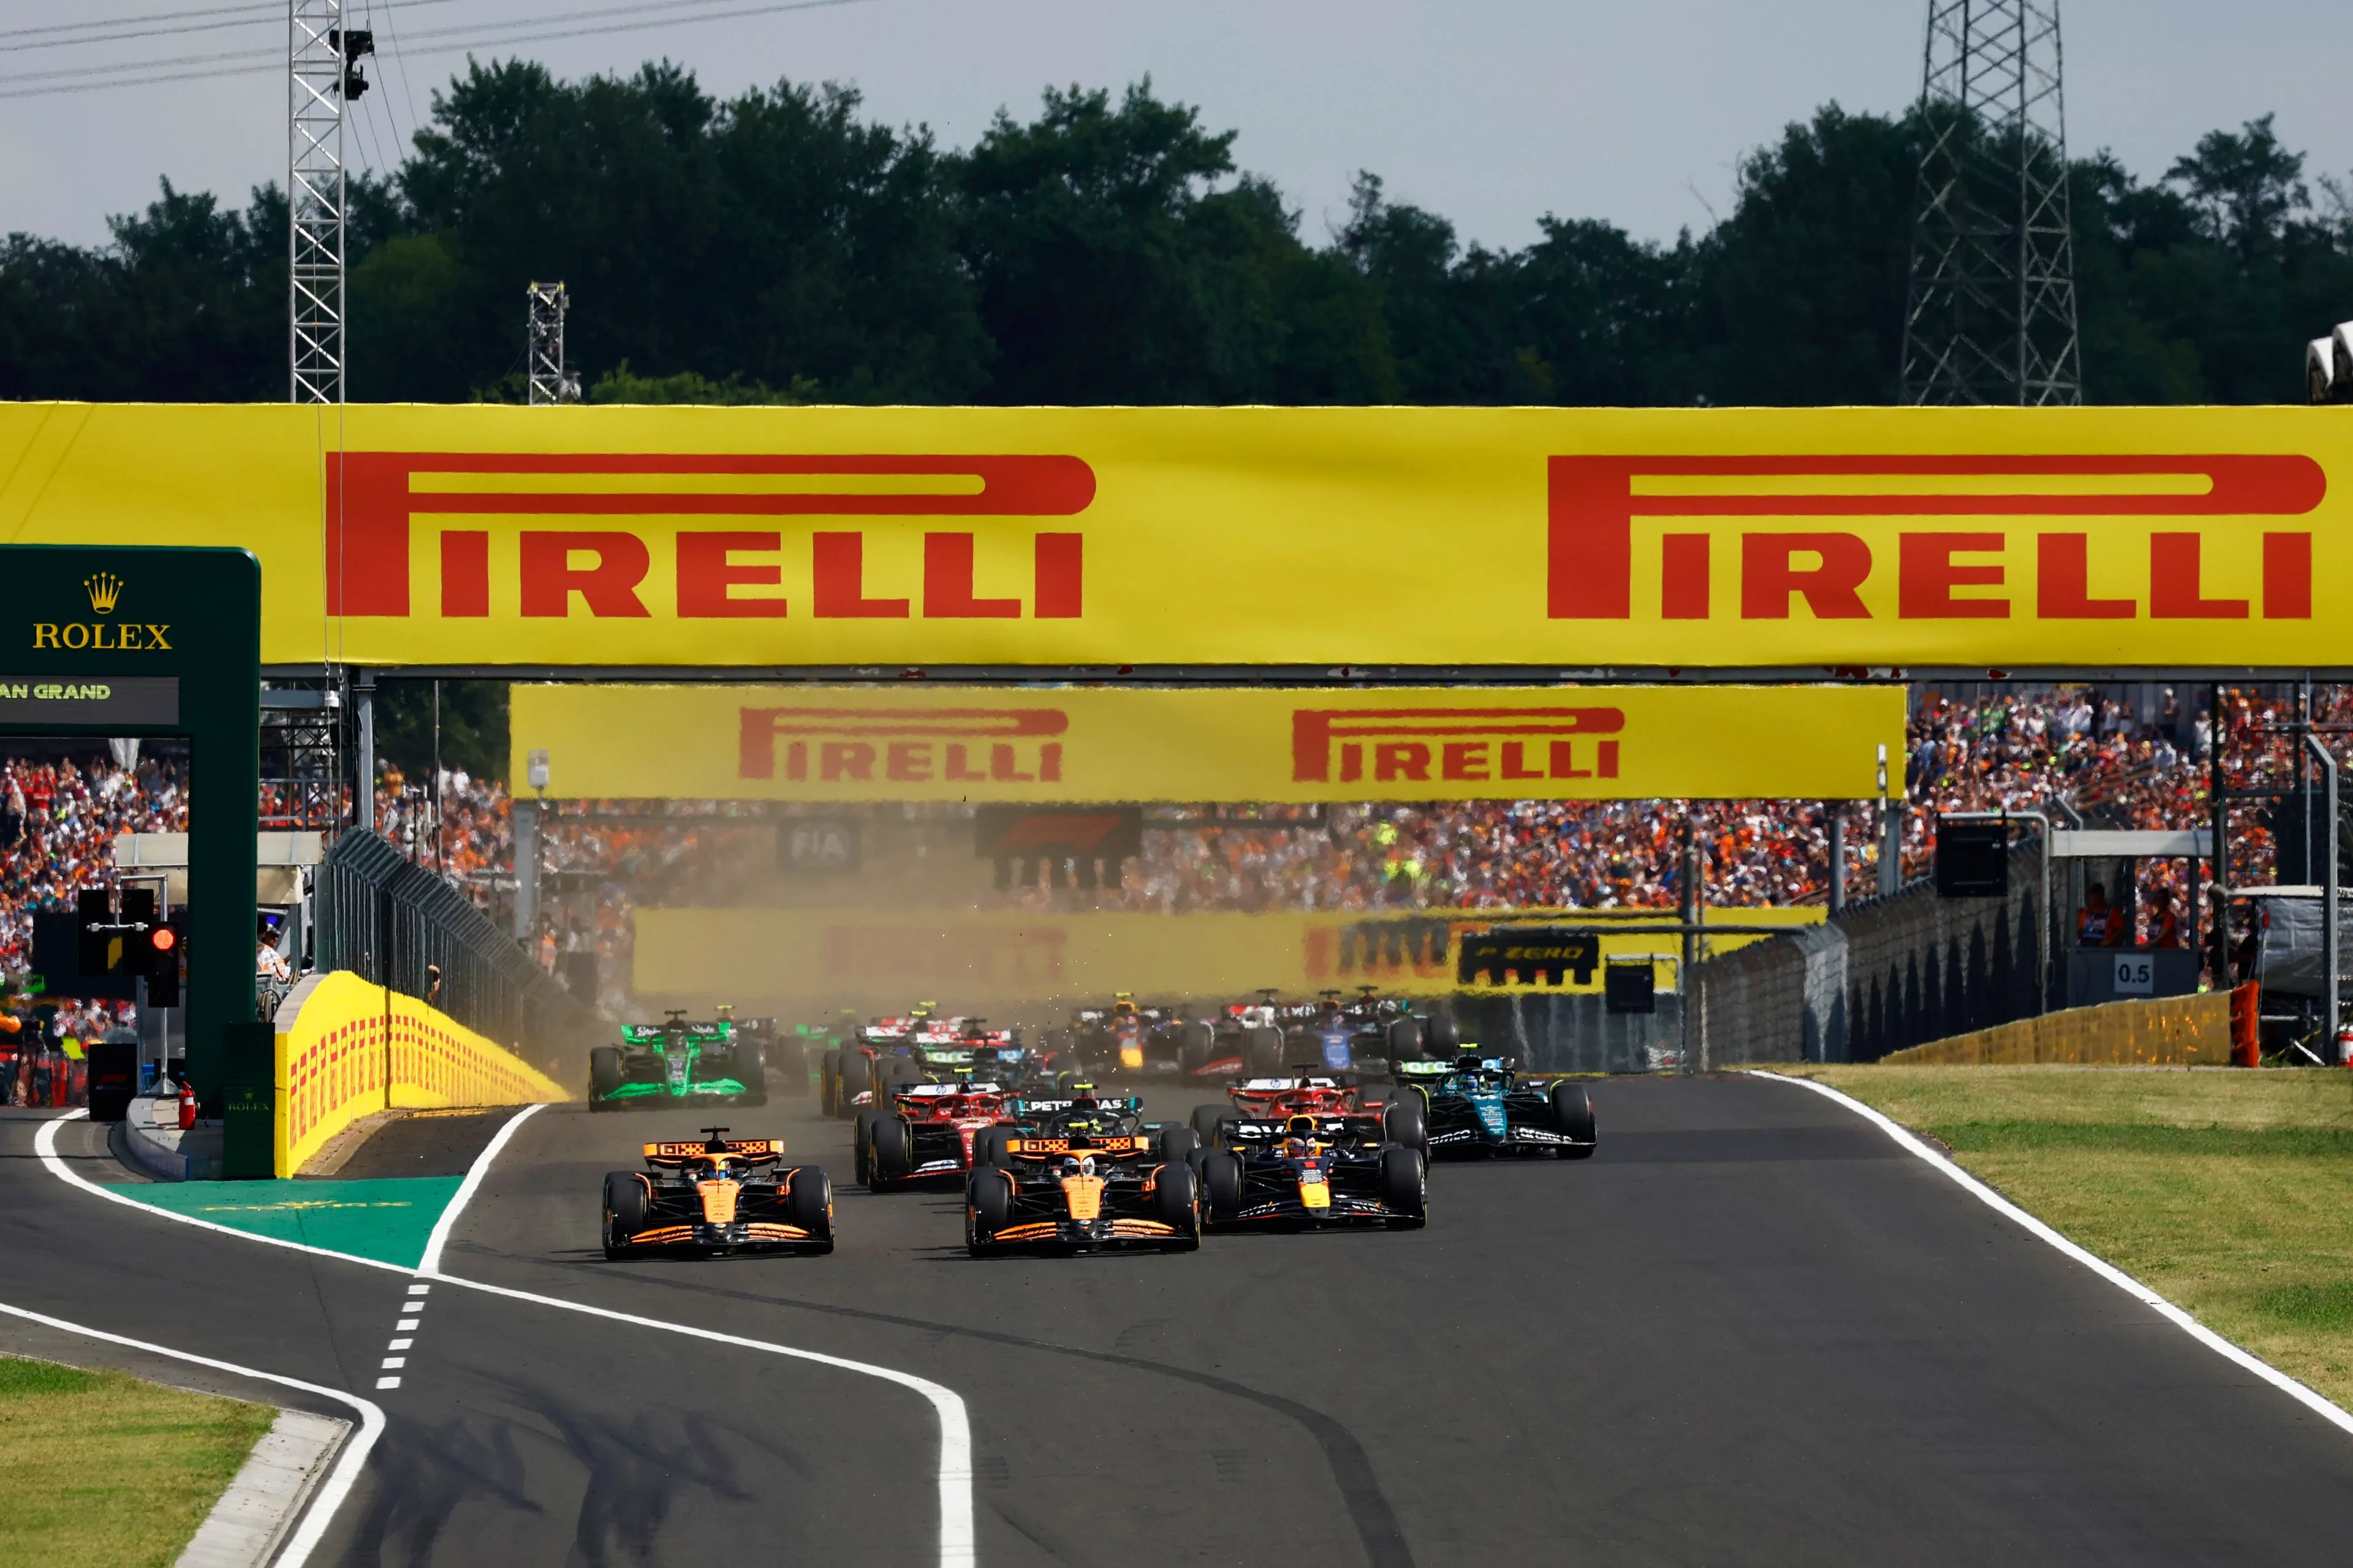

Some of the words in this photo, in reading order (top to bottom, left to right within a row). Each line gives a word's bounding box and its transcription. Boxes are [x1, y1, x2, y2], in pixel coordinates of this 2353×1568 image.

[325, 452, 1097, 619] PIRELLI
[1547, 454, 2327, 619] PIRELLI
[32, 623, 173, 650] ROLEX
[33, 684, 111, 699] GRAND
[739, 708, 1069, 782] PIRELLI
[1292, 708, 1625, 782] PIRELLI
[2118, 963, 2150, 983] 0.5
[229, 1102, 270, 1111] ROLEX
[1030, 1099, 1122, 1112] PETRAS
